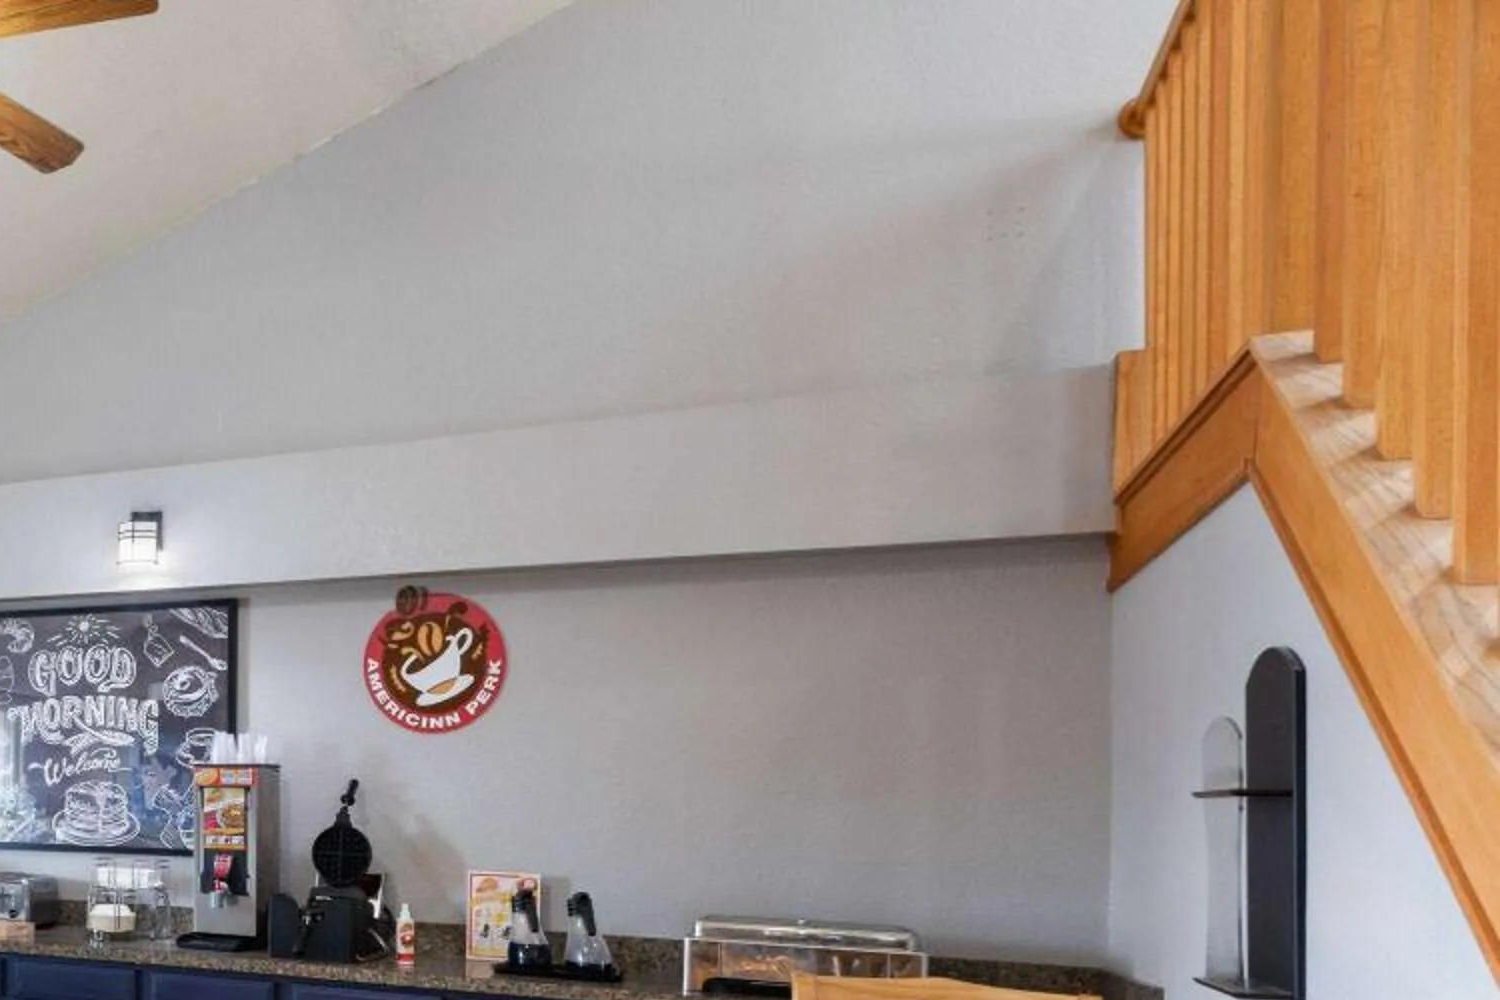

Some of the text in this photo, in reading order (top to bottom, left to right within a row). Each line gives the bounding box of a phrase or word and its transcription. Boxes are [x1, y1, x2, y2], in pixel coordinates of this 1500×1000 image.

[27, 645, 137, 696] GOOD
[367, 658, 502, 729] AMERICINN PERK
[7, 694, 160, 755] MORNING
[28, 747, 133, 786] Welcome
